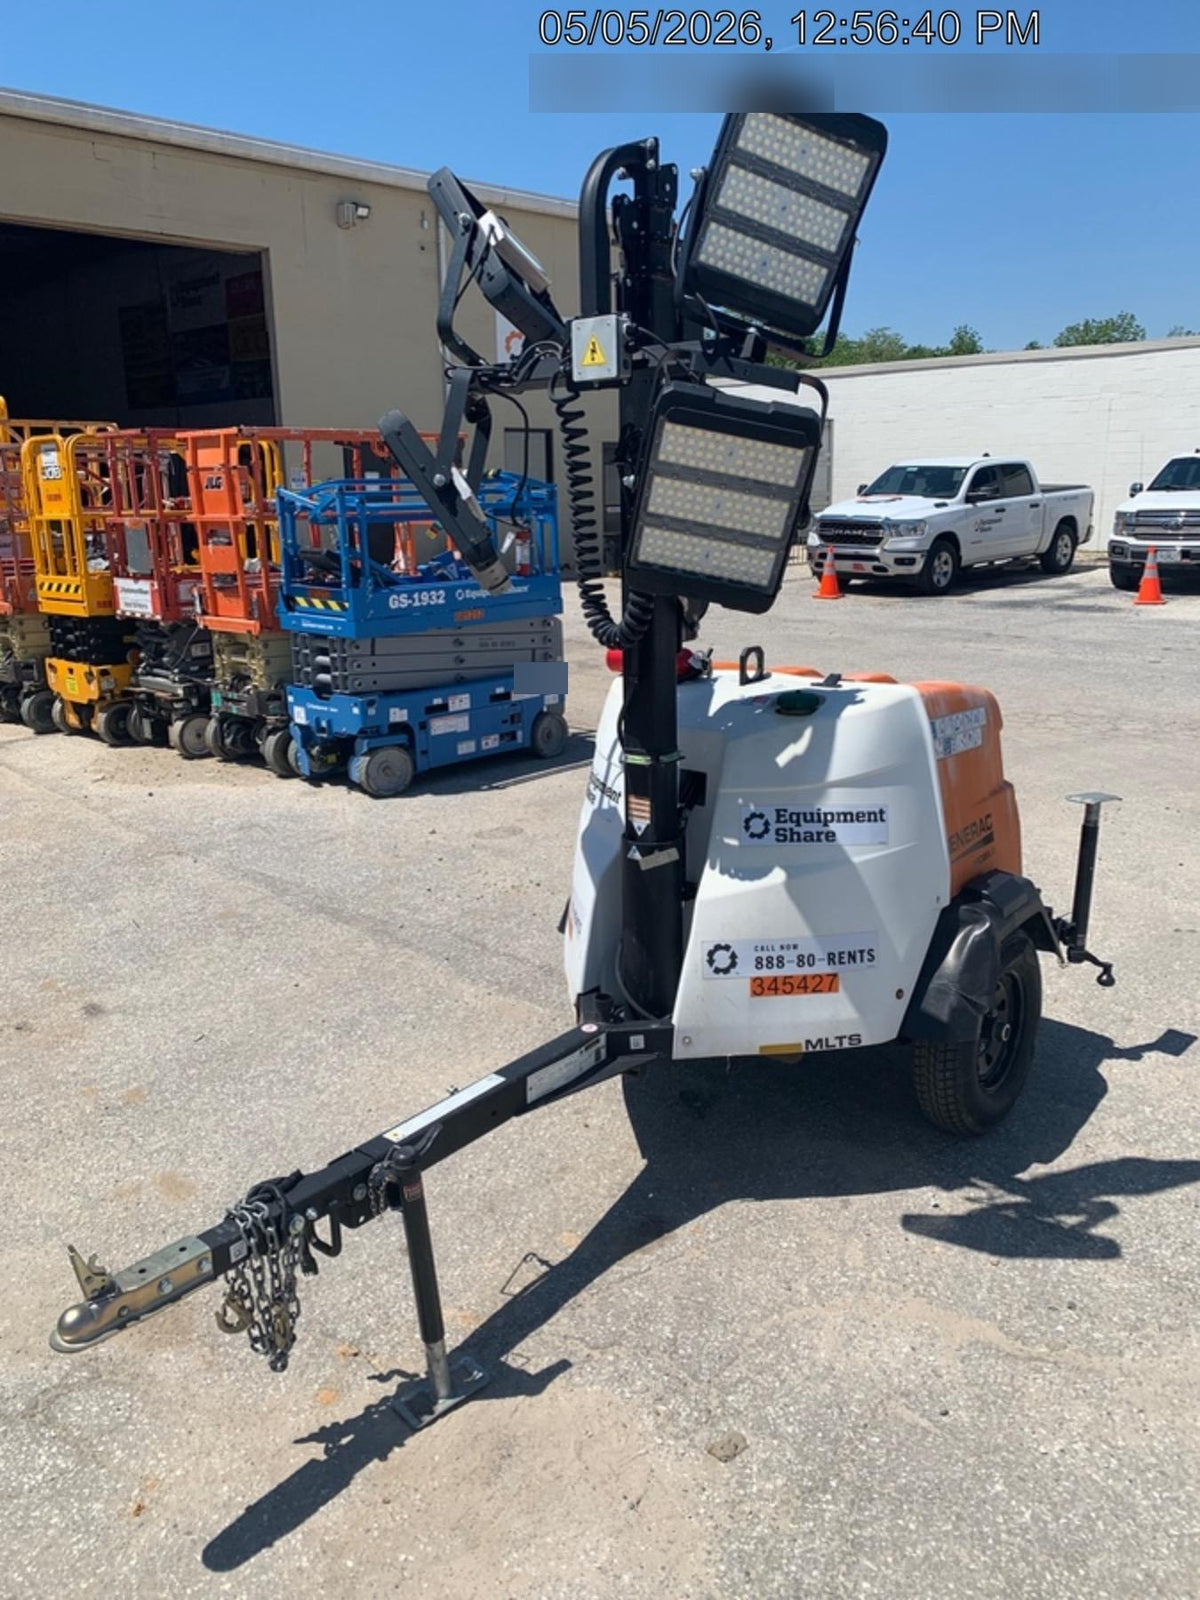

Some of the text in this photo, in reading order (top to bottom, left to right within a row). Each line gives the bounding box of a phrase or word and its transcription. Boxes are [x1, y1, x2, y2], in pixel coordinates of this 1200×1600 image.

[388, 590, 446, 609] GS-1932
[775, 808, 886, 827] Equipment
[775, 828, 837, 843] Share
[949, 814, 993, 852] ENERAC
[754, 943, 799, 953] CALL NOW
[754, 949, 876, 971] 888-80-RENTS
[752, 974, 839, 997] 345427
[805, 1033, 863, 1051] MLTS
